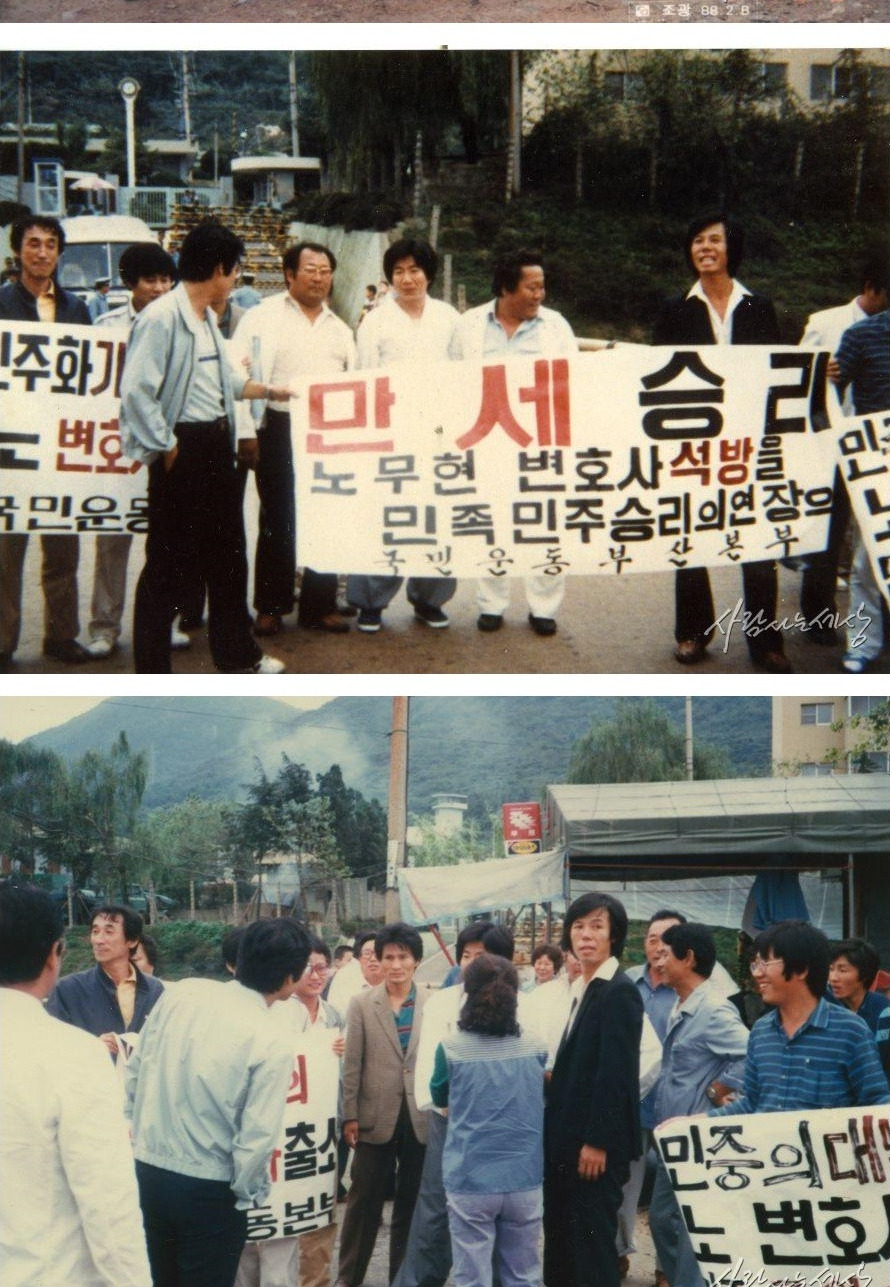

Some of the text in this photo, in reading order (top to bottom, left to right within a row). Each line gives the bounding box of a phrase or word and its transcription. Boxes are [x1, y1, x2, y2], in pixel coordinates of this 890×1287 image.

[56, 418, 143, 475] 변호
[310, 449, 477, 496] 노무현
[518, 444, 663, 492] 변호사
[660, 1120, 823, 1192] 민중의
[682, 1195, 890, 1266] 노 변호
